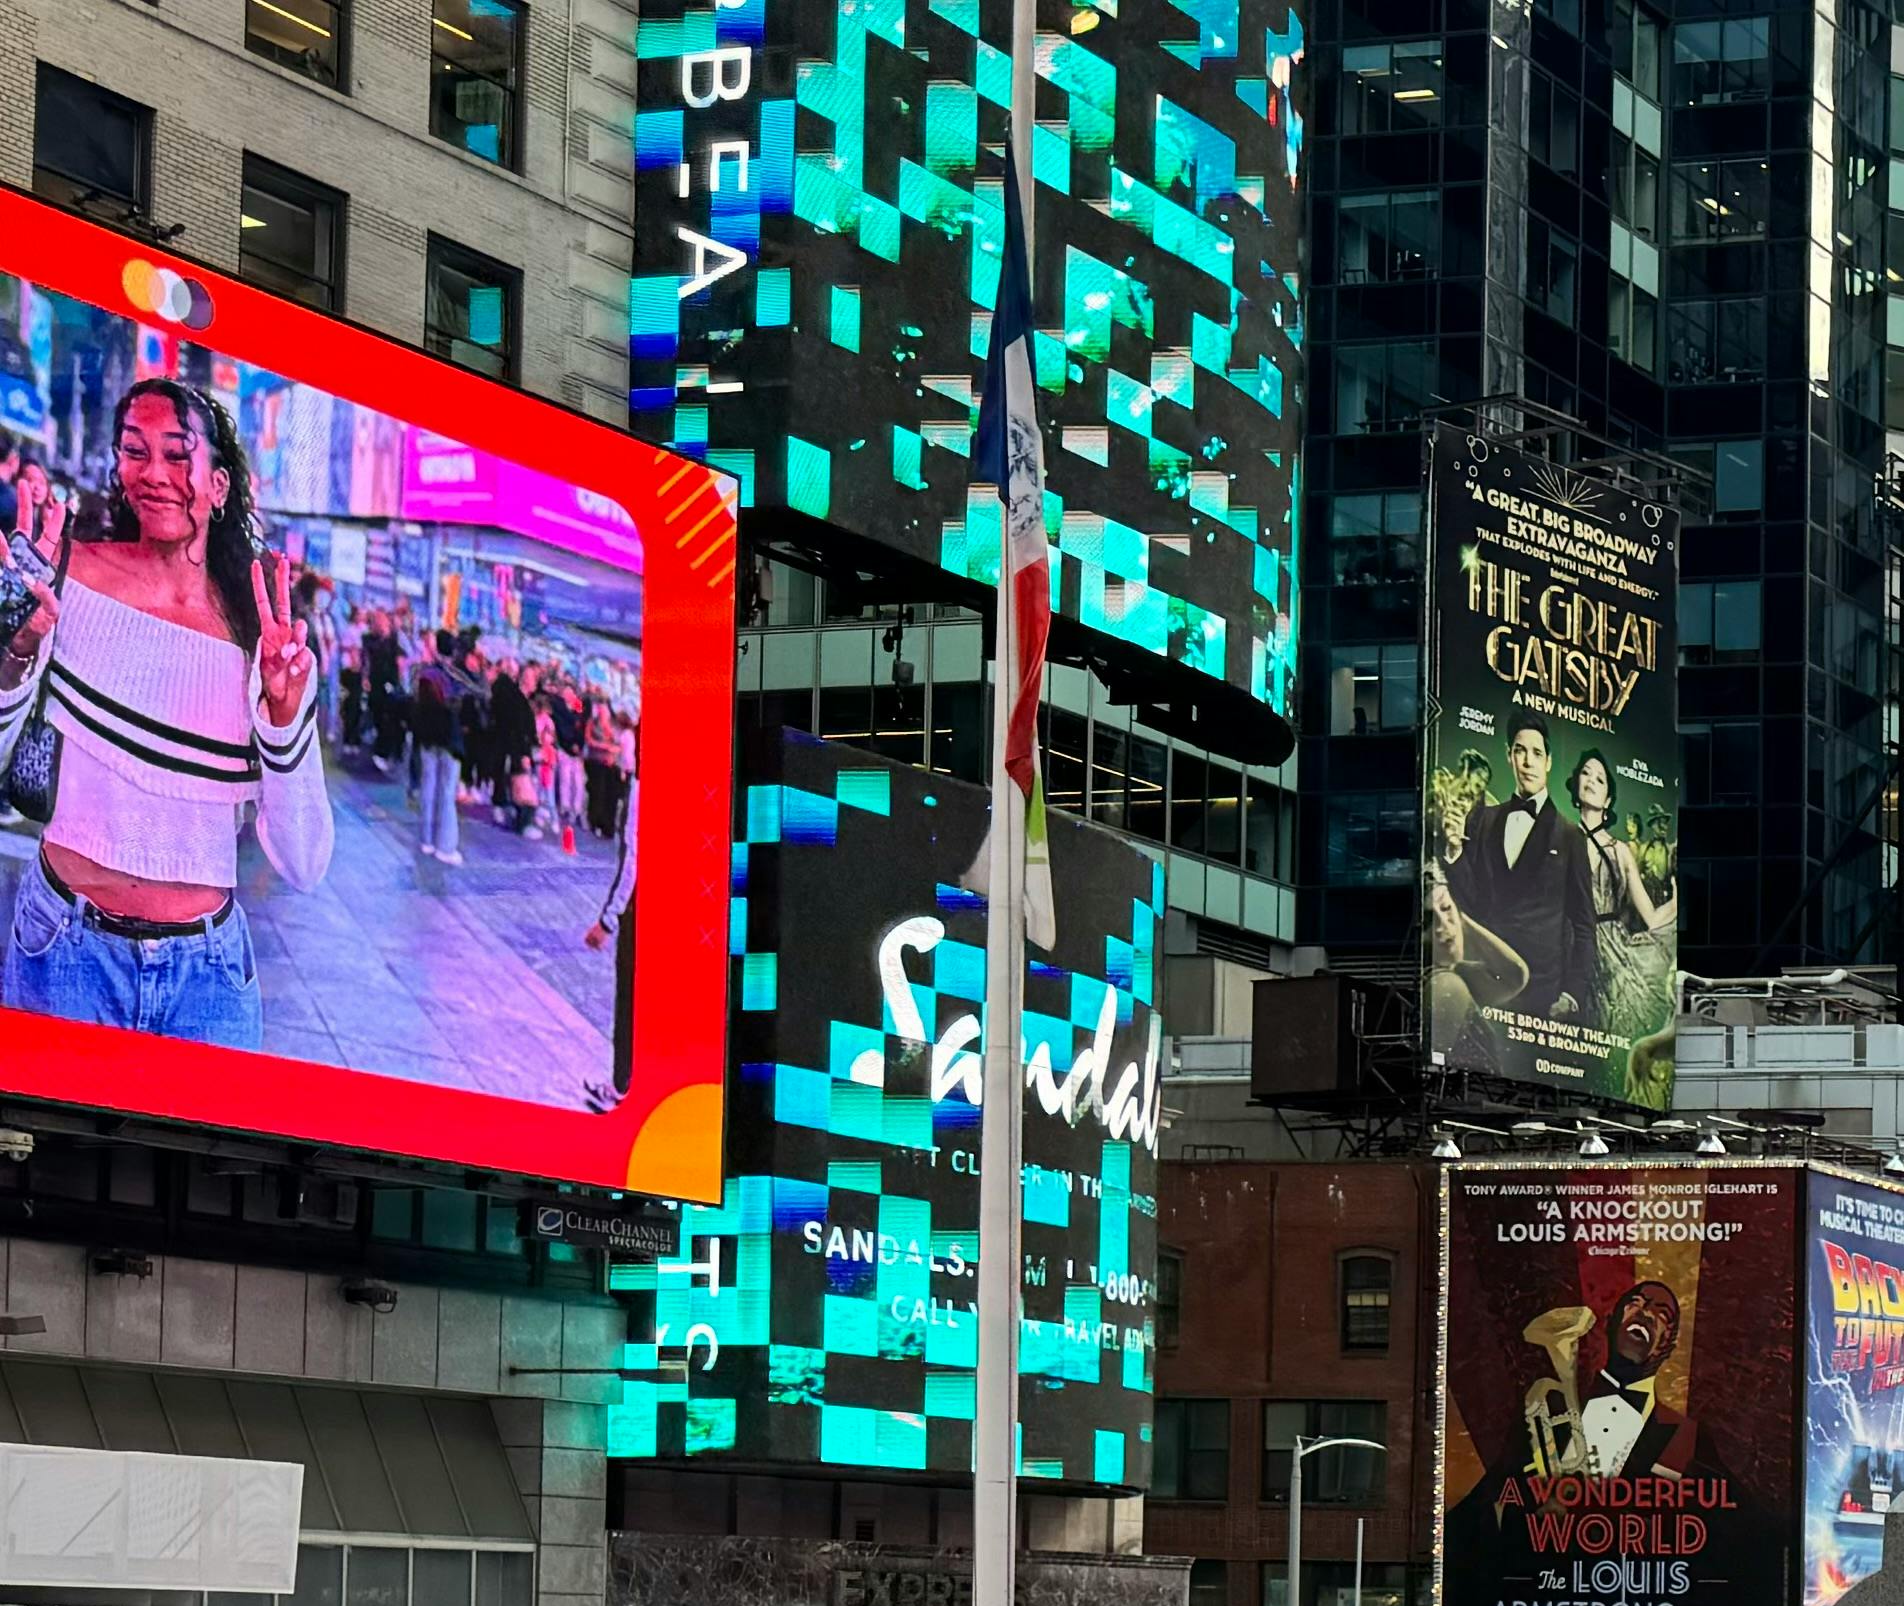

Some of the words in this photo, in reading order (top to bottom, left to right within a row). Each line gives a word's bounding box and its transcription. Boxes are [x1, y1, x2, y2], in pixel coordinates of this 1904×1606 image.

[1487, 488, 1541, 524] GREAT,
[1542, 508, 1570, 533] BIG
[1573, 518, 1658, 566] BROADWAY
[1507, 516, 1628, 577] EXTRAVAGANZA
[1539, 585, 1663, 672] GREAT
[1486, 625, 1640, 716] GATSBY
[1525, 692, 1557, 716] NEW
[1558, 706, 1616, 735] MUSICAL
[1517, 1014, 1580, 1038] BROADWAY
[1582, 1027, 1631, 1050] THEATRE
[1548, 1037, 1610, 1059] BROADWAY
[1464, 1184, 1498, 1196] TONY
[1555, 1184, 1604, 1196] WINNER
[1607, 1184, 1646, 1195] JAMES
[1650, 1184, 1701, 1195] MONROE
[1704, 1184, 1763, 1195] IGLEHART
[1570, 1200, 1703, 1220] KNOCKOUT
[1497, 1222, 1566, 1243] LOUIS
[1573, 1222, 1744, 1243] ARMSTRONG!”
[1499, 1477, 1525, 1508] A
[1526, 1477, 1738, 1509] WONDERFUL
[1526, 1513, 1708, 1555] WORLD
[1538, 1570, 1566, 1590] The
[1573, 1560, 1691, 1595] LOUIS
